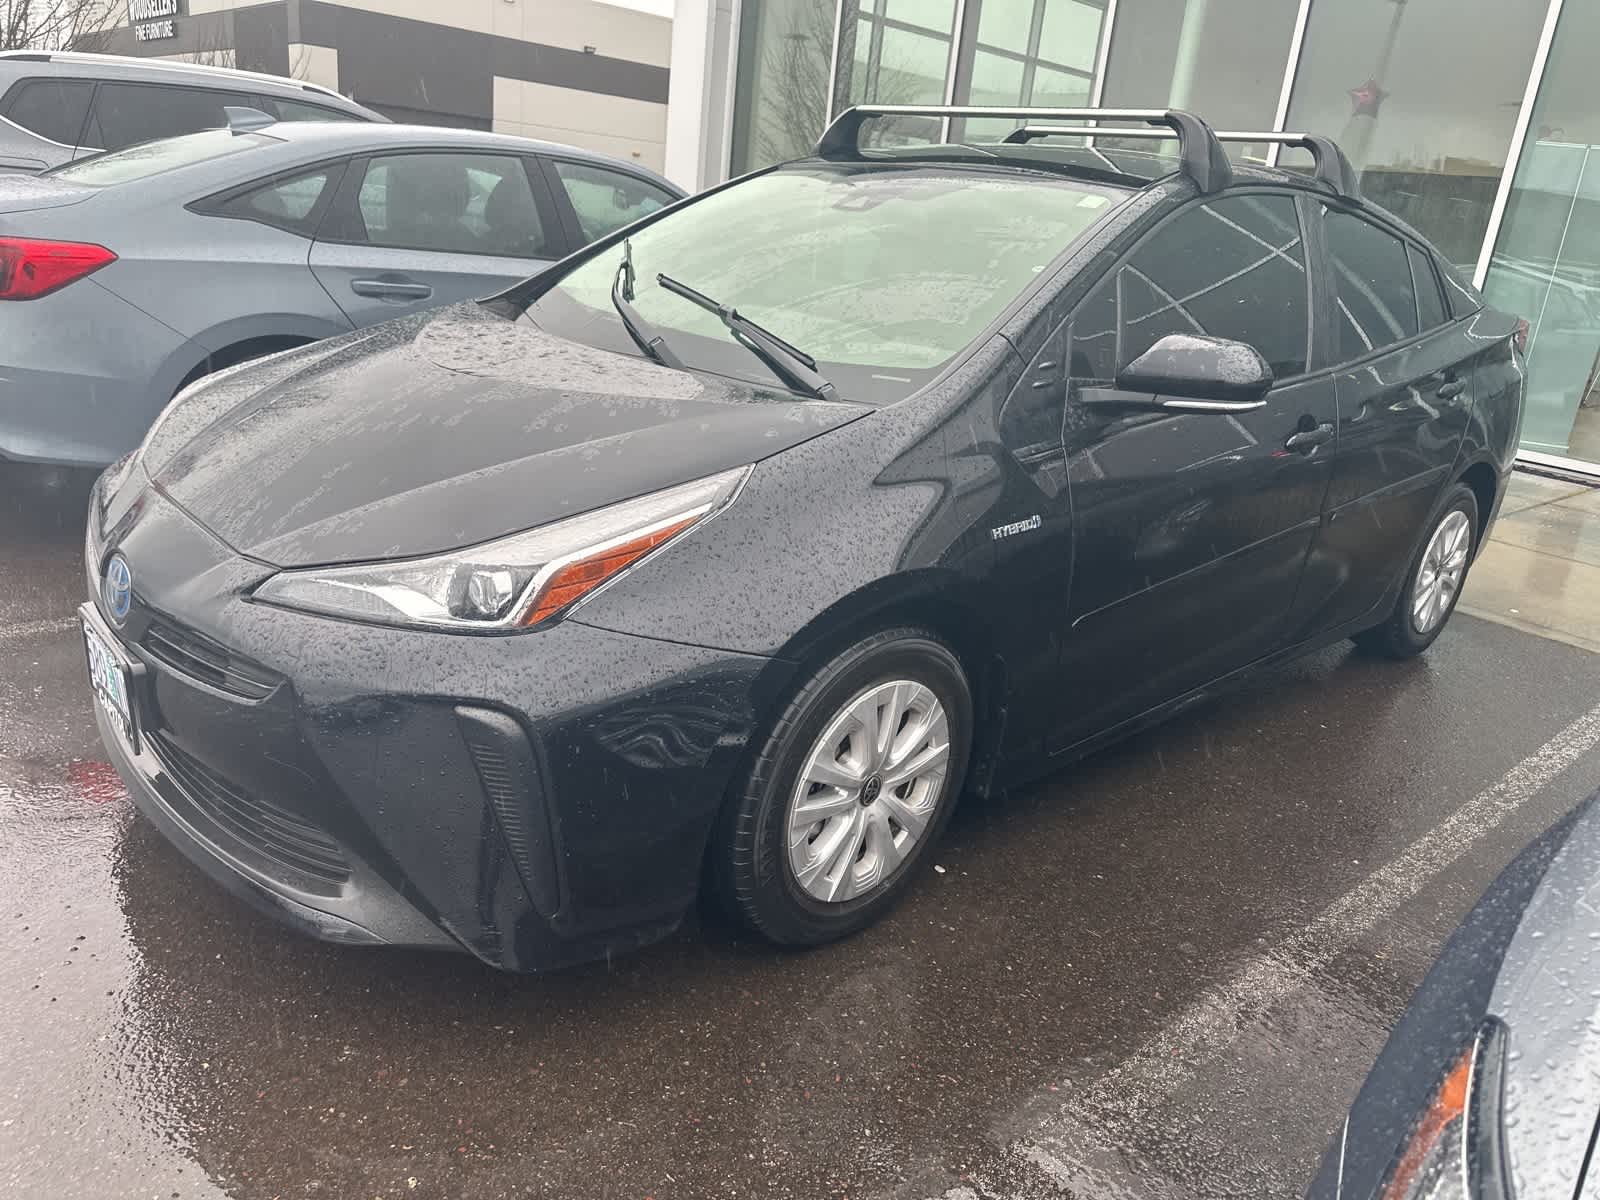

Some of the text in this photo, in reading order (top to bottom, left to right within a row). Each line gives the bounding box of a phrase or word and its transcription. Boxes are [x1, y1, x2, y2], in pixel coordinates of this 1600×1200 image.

[135, 20, 174, 41] FINE FURNITURE
[992, 518, 1034, 540] HYBRID
